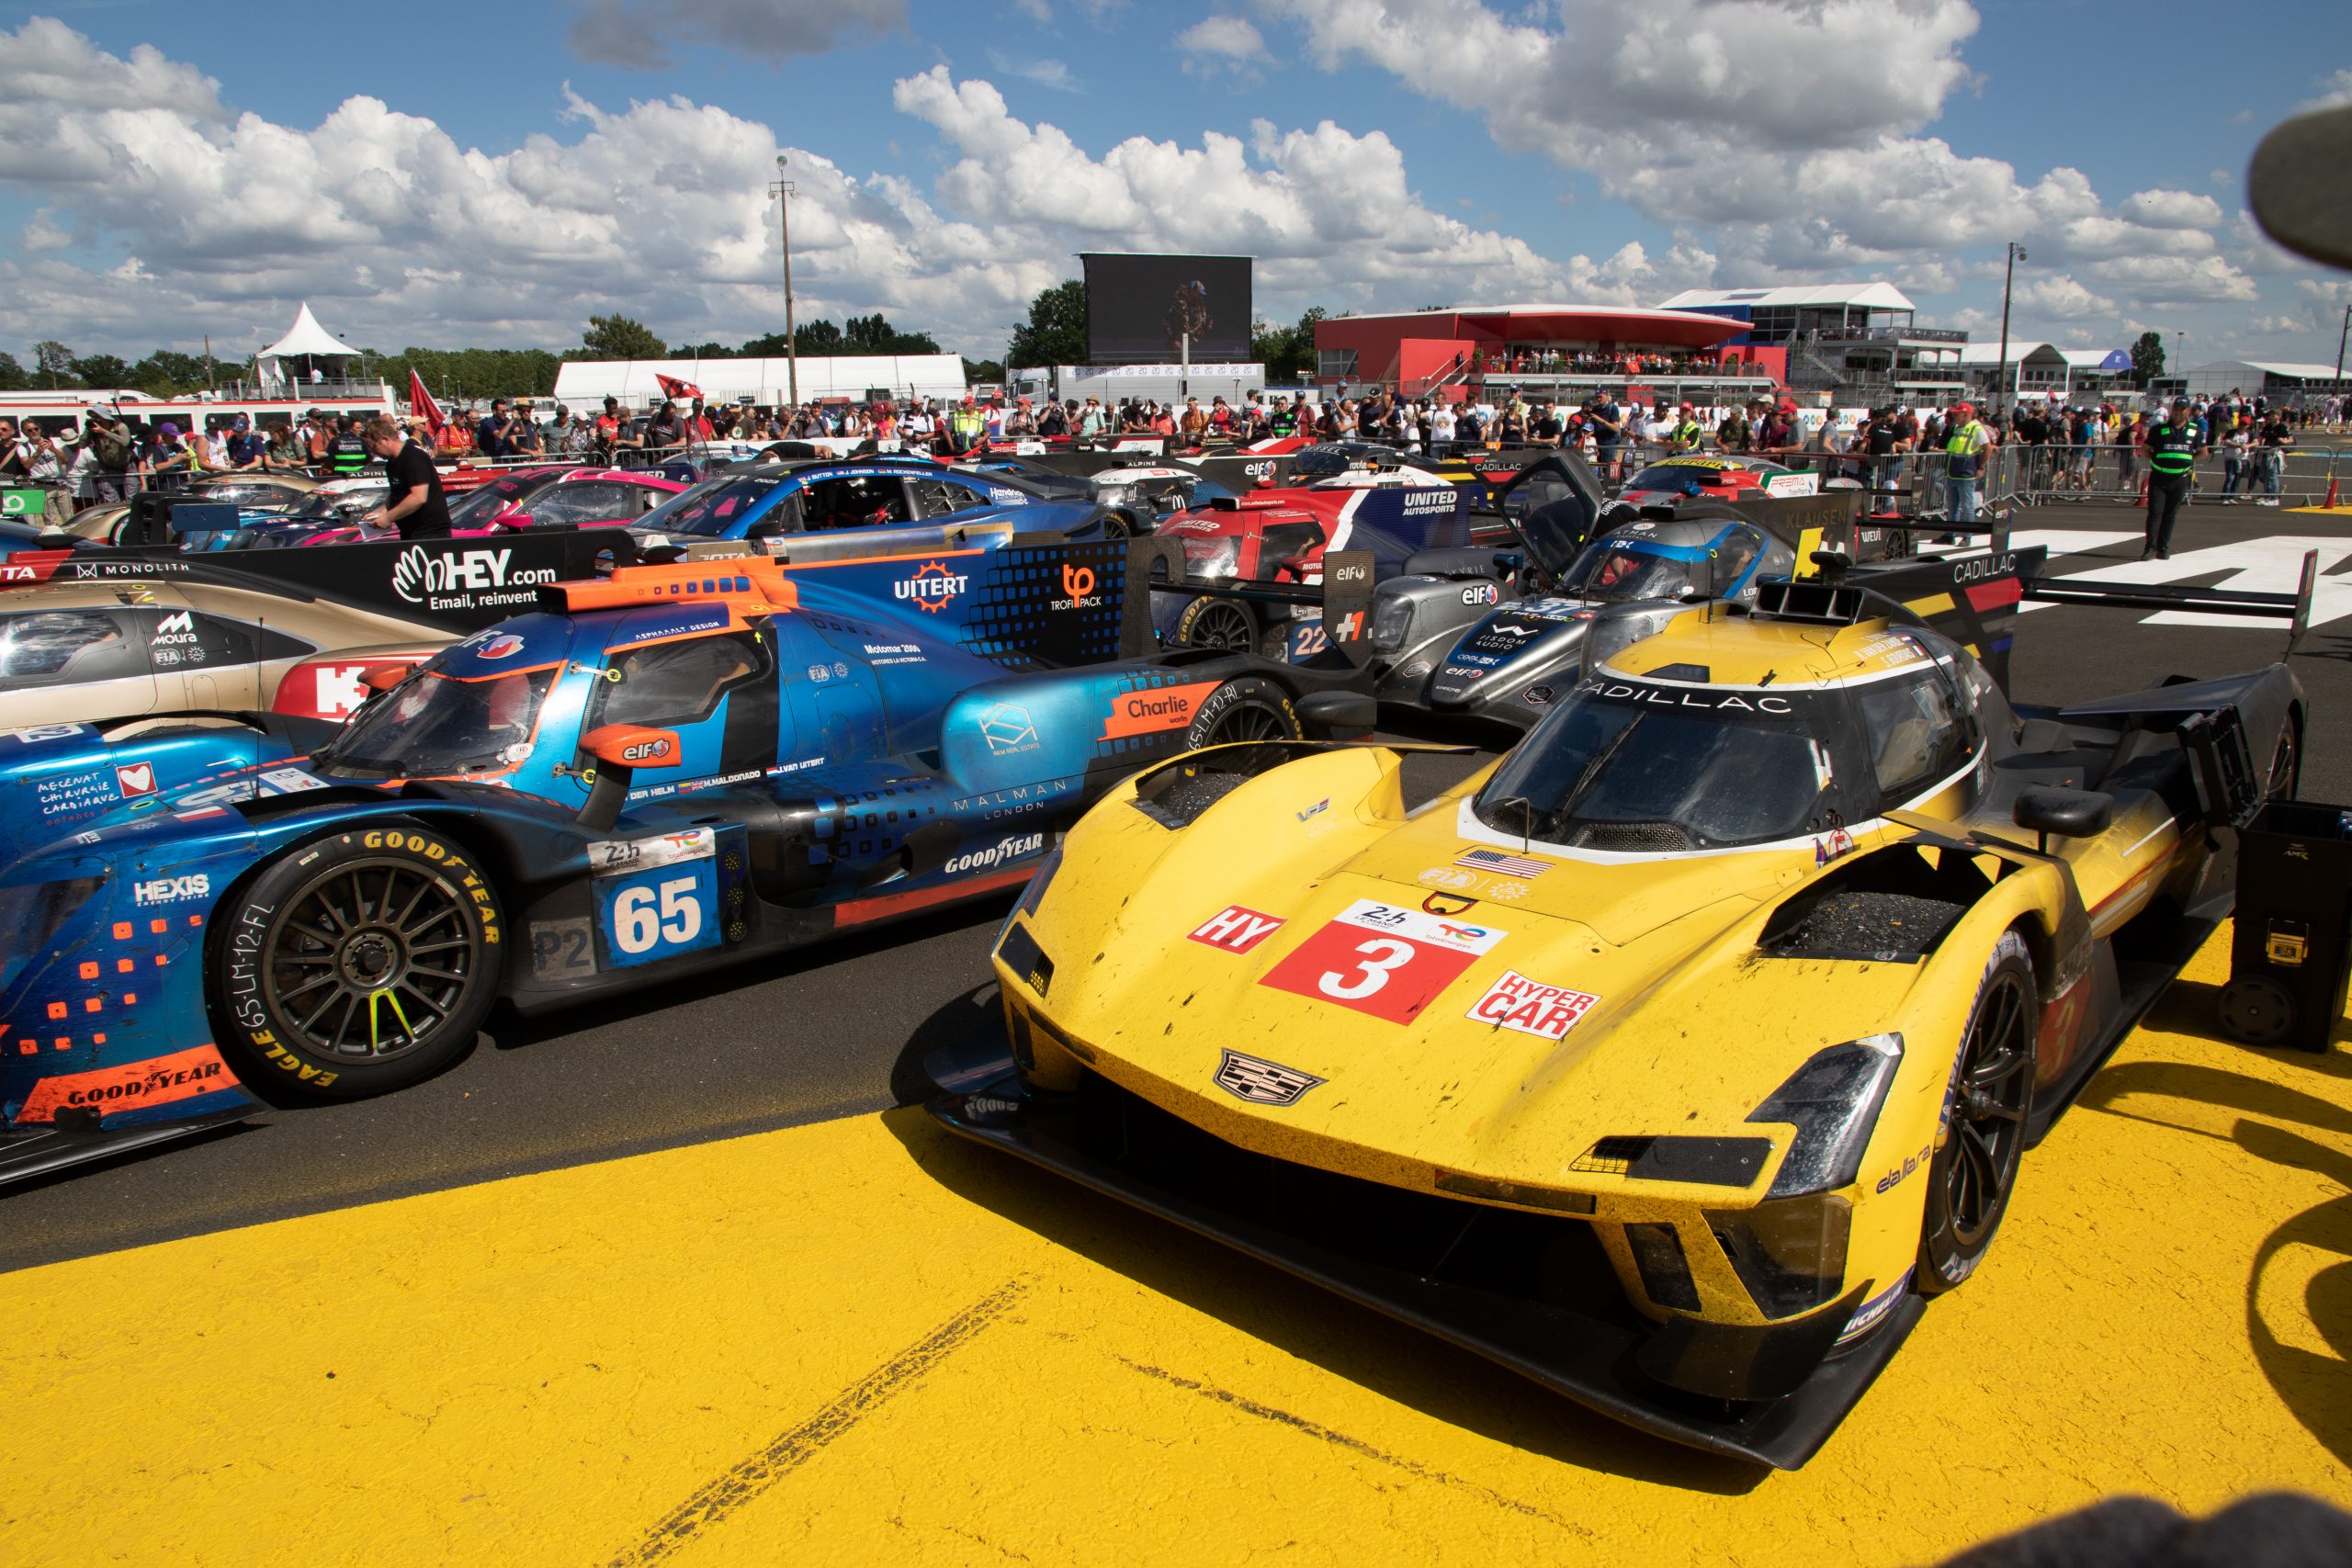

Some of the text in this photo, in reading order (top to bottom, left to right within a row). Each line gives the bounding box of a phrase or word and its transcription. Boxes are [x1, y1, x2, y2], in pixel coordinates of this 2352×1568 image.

[1245, 463, 1264, 476] elf
[1475, 462, 1522, 472] CADILLAC
[1402, 503, 1455, 516] AUTOSPORTS
[1404, 491, 1457, 506] UNITED
[1785, 508, 1848, 530] KLAUSEN
[105, 562, 190, 575] MONOLITH
[1302, 562, 1323, 570] MOTUL
[1336, 566, 1356, 581] elf
[1952, 552, 2017, 585] CADILLAC
[894, 574, 968, 600] UITERT
[1462, 587, 1486, 605] elf
[430, 589, 537, 611] Email, reinvent
[689, 621, 720, 631] DESIGN
[864, 644, 902, 655] Motomar
[1295, 626, 1328, 656] 22
[1476, 641, 1513, 650] AUDIO
[1127, 695, 1189, 719] Charlie
[1574, 677, 1792, 715] CADILLAC
[1169, 716, 1189, 725] works
[623, 742, 652, 760] elf
[629, 788, 649, 801] DER
[650, 784, 674, 798] HELM
[799, 756, 825, 770] UITERT
[954, 779, 1068, 812] MALMAN
[984, 801, 1045, 820] LONDON
[667, 847, 706, 861] TotalEnergies
[944, 832, 1043, 874] GOODYEAR
[133, 874, 209, 902] HEXIS
[614, 875, 702, 954] 65
[1193, 908, 1283, 949] HY
[534, 927, 591, 972] P2
[1424, 933, 1472, 950] TotalEnergies
[1317, 938, 1416, 1000] 3
[1498, 974, 1597, 1011] HYPER
[1475, 992, 1577, 1036] CAR
[250, 1028, 339, 1089] EAGLE
[68, 1061, 221, 1106] GOODYEAR
[1875, 1144, 1931, 1195] dallara
